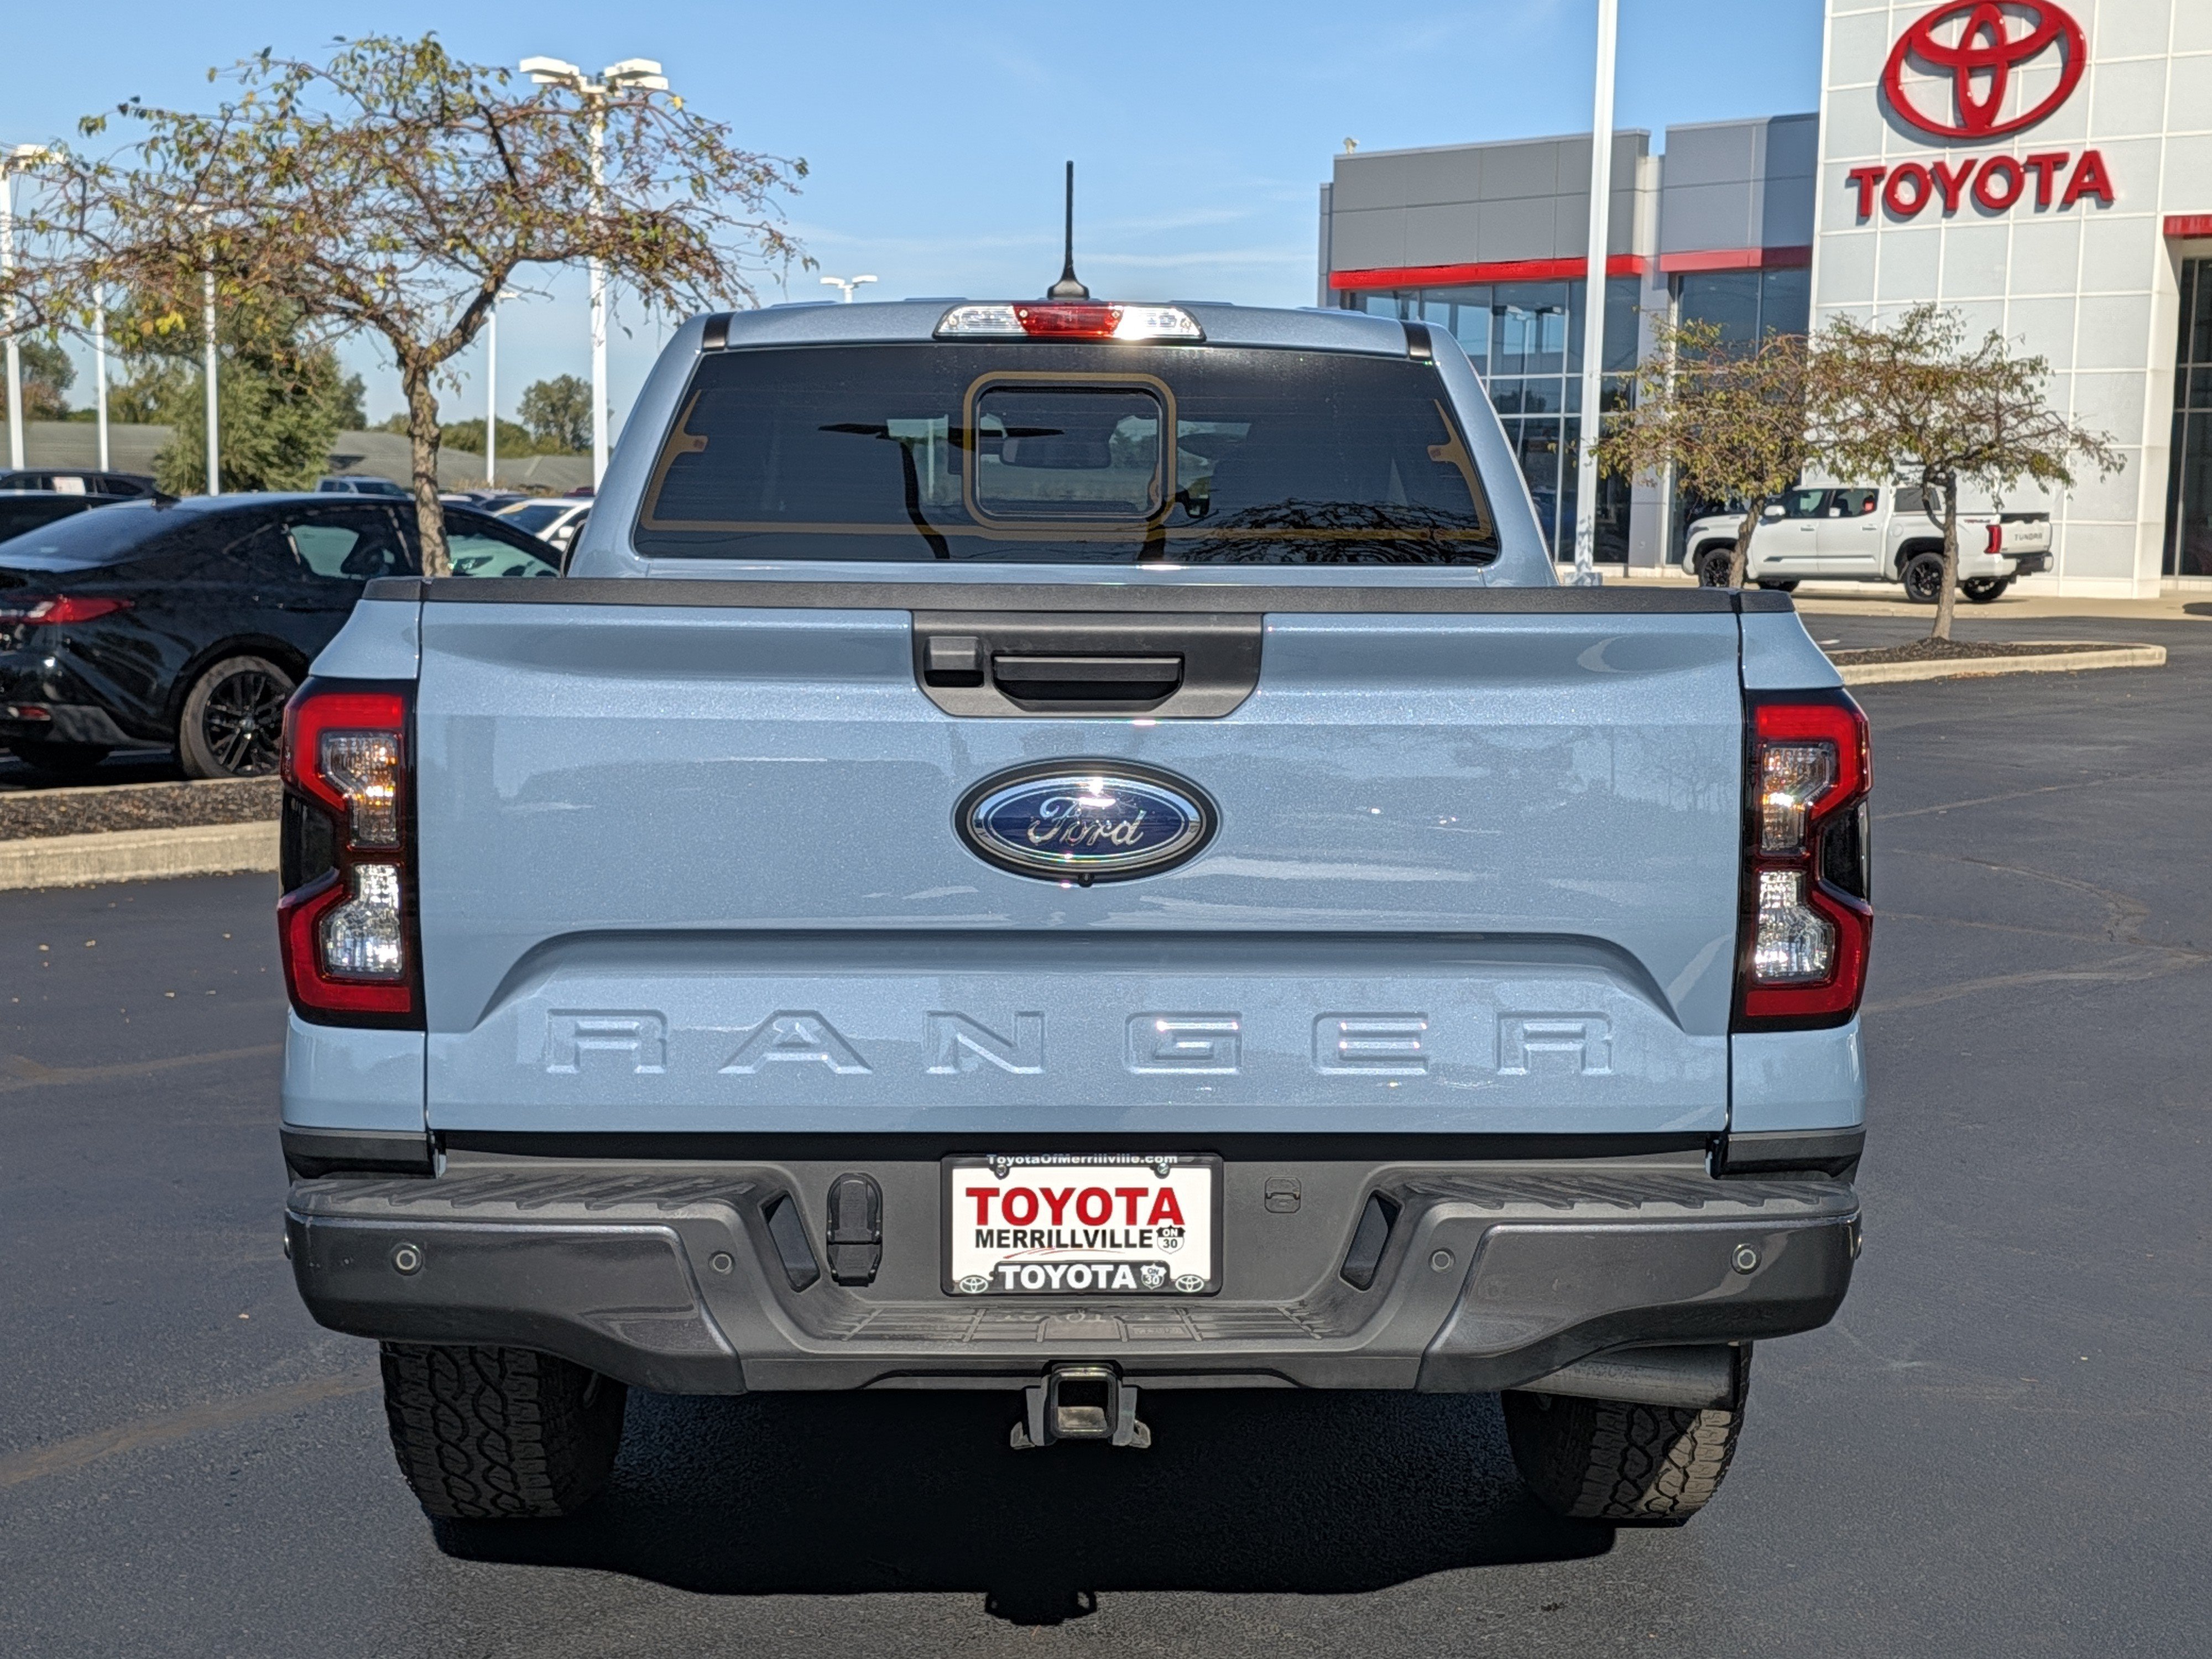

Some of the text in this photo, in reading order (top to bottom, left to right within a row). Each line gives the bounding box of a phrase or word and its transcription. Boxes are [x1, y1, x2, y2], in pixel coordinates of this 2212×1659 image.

[1850, 150, 2115, 217] TOYOTA
[1027, 796, 1147, 846] Ford
[546, 1009, 1612, 1075] RANGER
[987, 1154, 1178, 1166] ToyotaOfMerrillville.com
[966, 1187, 1186, 1226] TOYOTA
[975, 1229, 1153, 1249] MERRILLVILLE
[1162, 1228, 1178, 1237] ON
[1163, 1239, 1178, 1249] 30
[998, 1264, 1137, 1290] TOYOTA
[1145, 1275, 1160, 1285] 30
